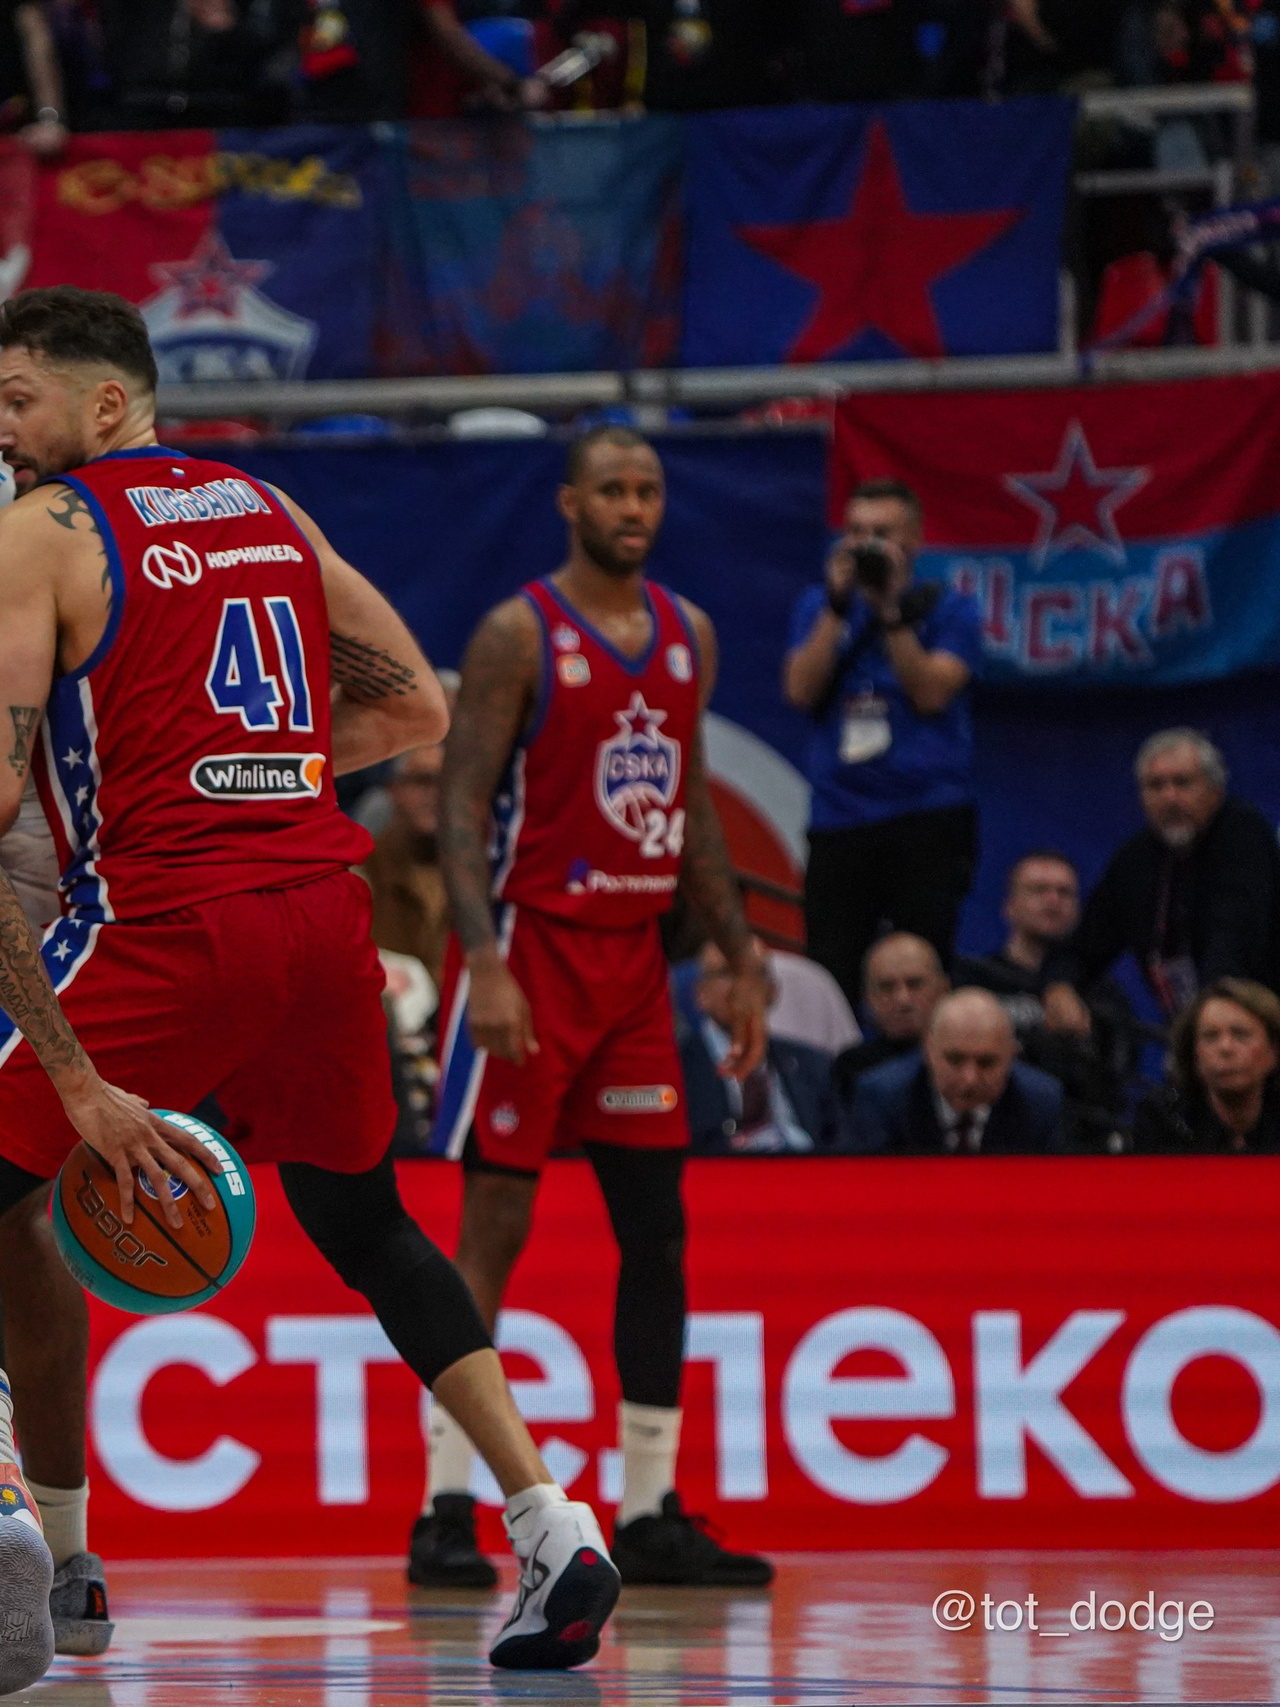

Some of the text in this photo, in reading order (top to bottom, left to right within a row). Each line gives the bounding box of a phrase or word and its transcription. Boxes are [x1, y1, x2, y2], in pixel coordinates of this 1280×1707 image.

[205, 545, 303, 570] НОРНИКЕЛЬ
[205, 596, 314, 732] 41
[204, 764, 297, 789] Winline
[609, 752, 670, 781] CSKA
